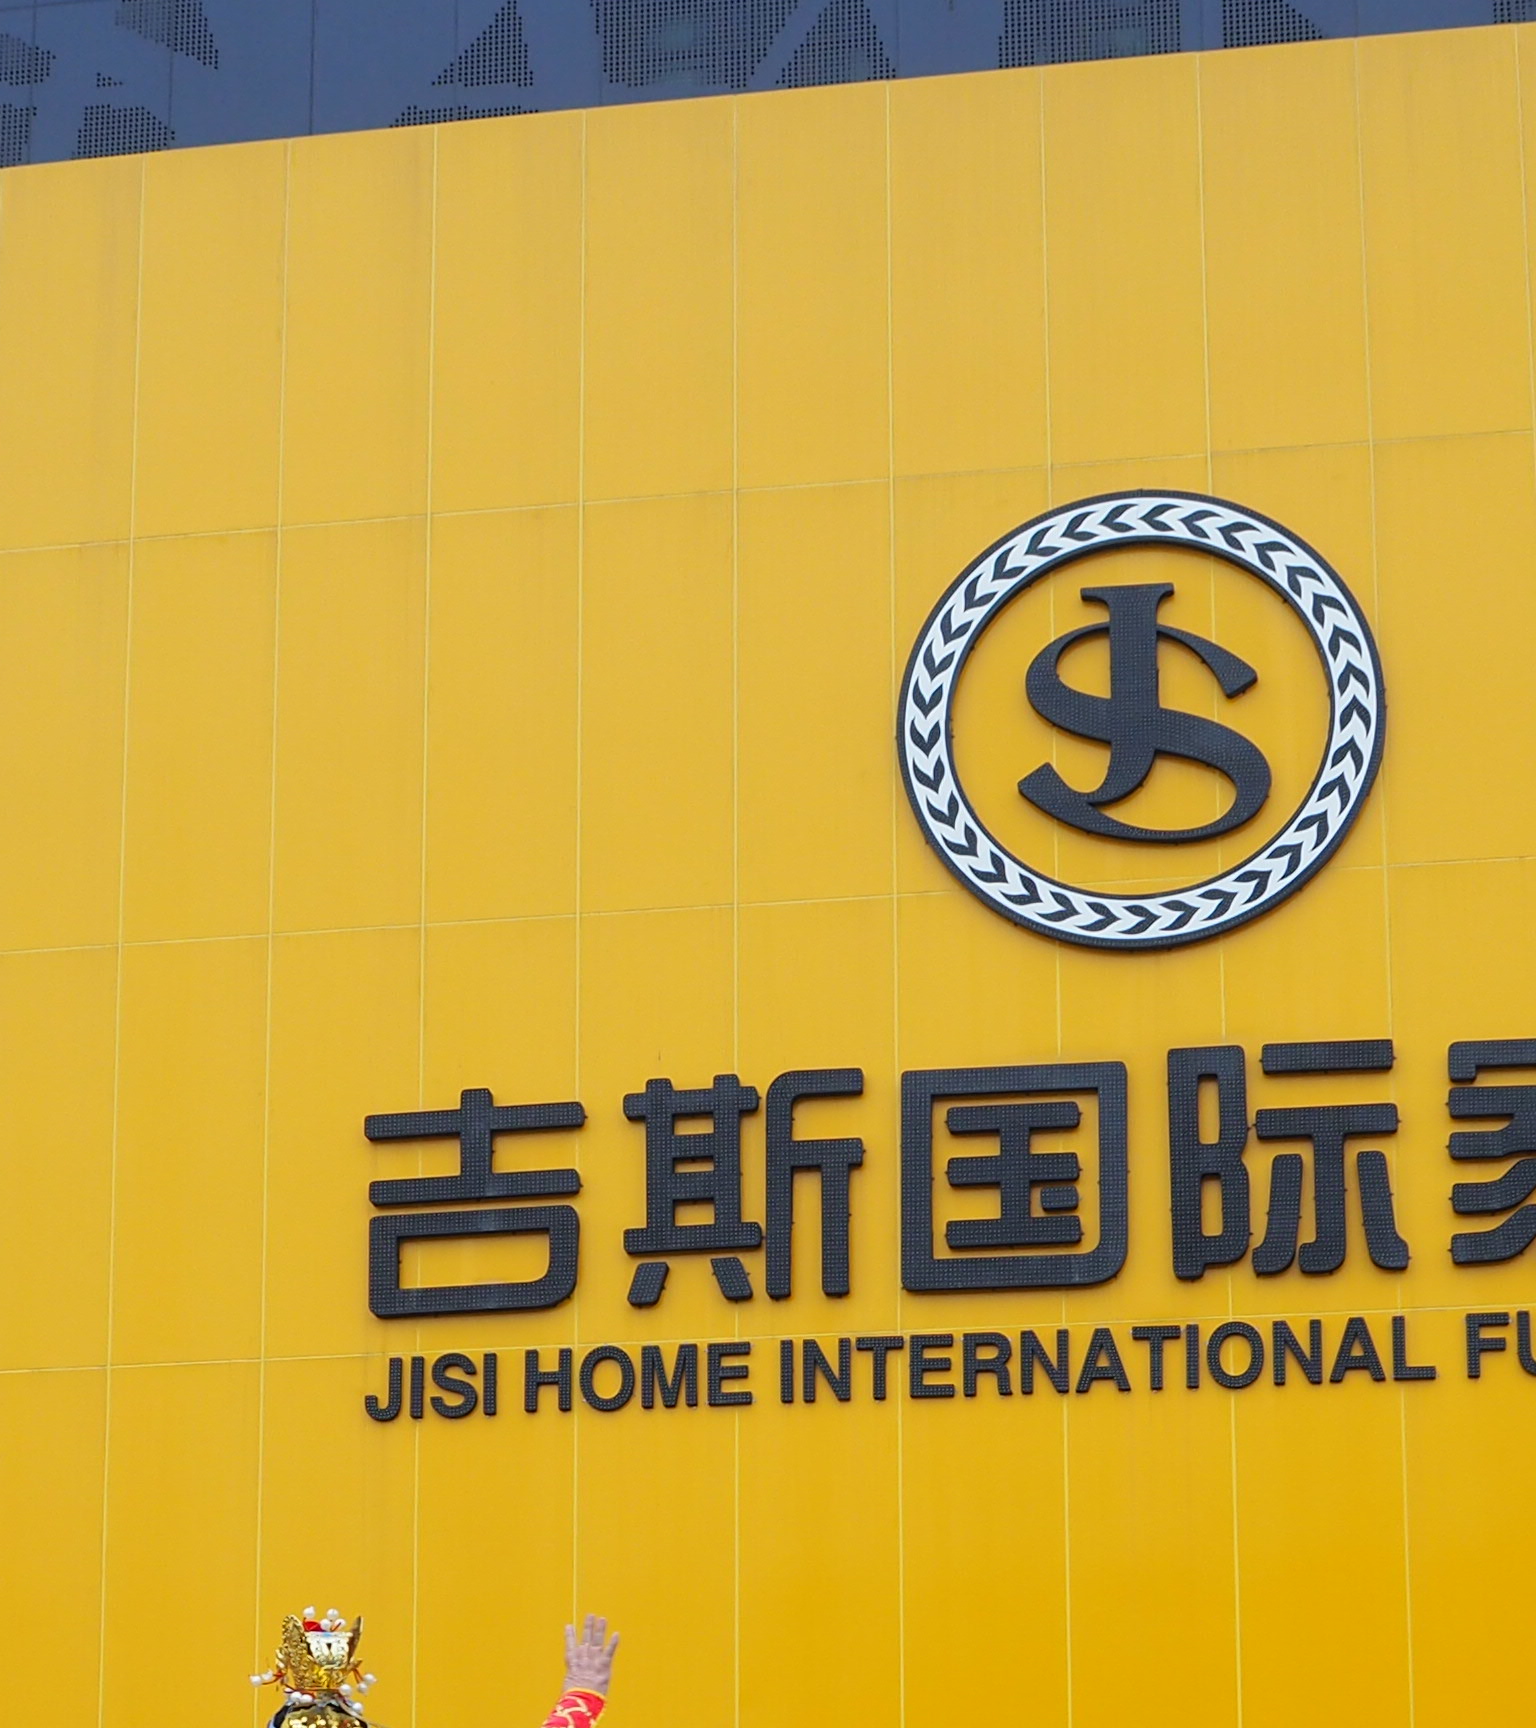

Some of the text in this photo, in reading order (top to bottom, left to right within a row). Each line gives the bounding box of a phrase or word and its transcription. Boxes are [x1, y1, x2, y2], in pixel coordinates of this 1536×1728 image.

[365, 1352, 497, 1422] JISI
[524, 1341, 753, 1413] HOME
[779, 1315, 1436, 1405] INTERNATIONAL
